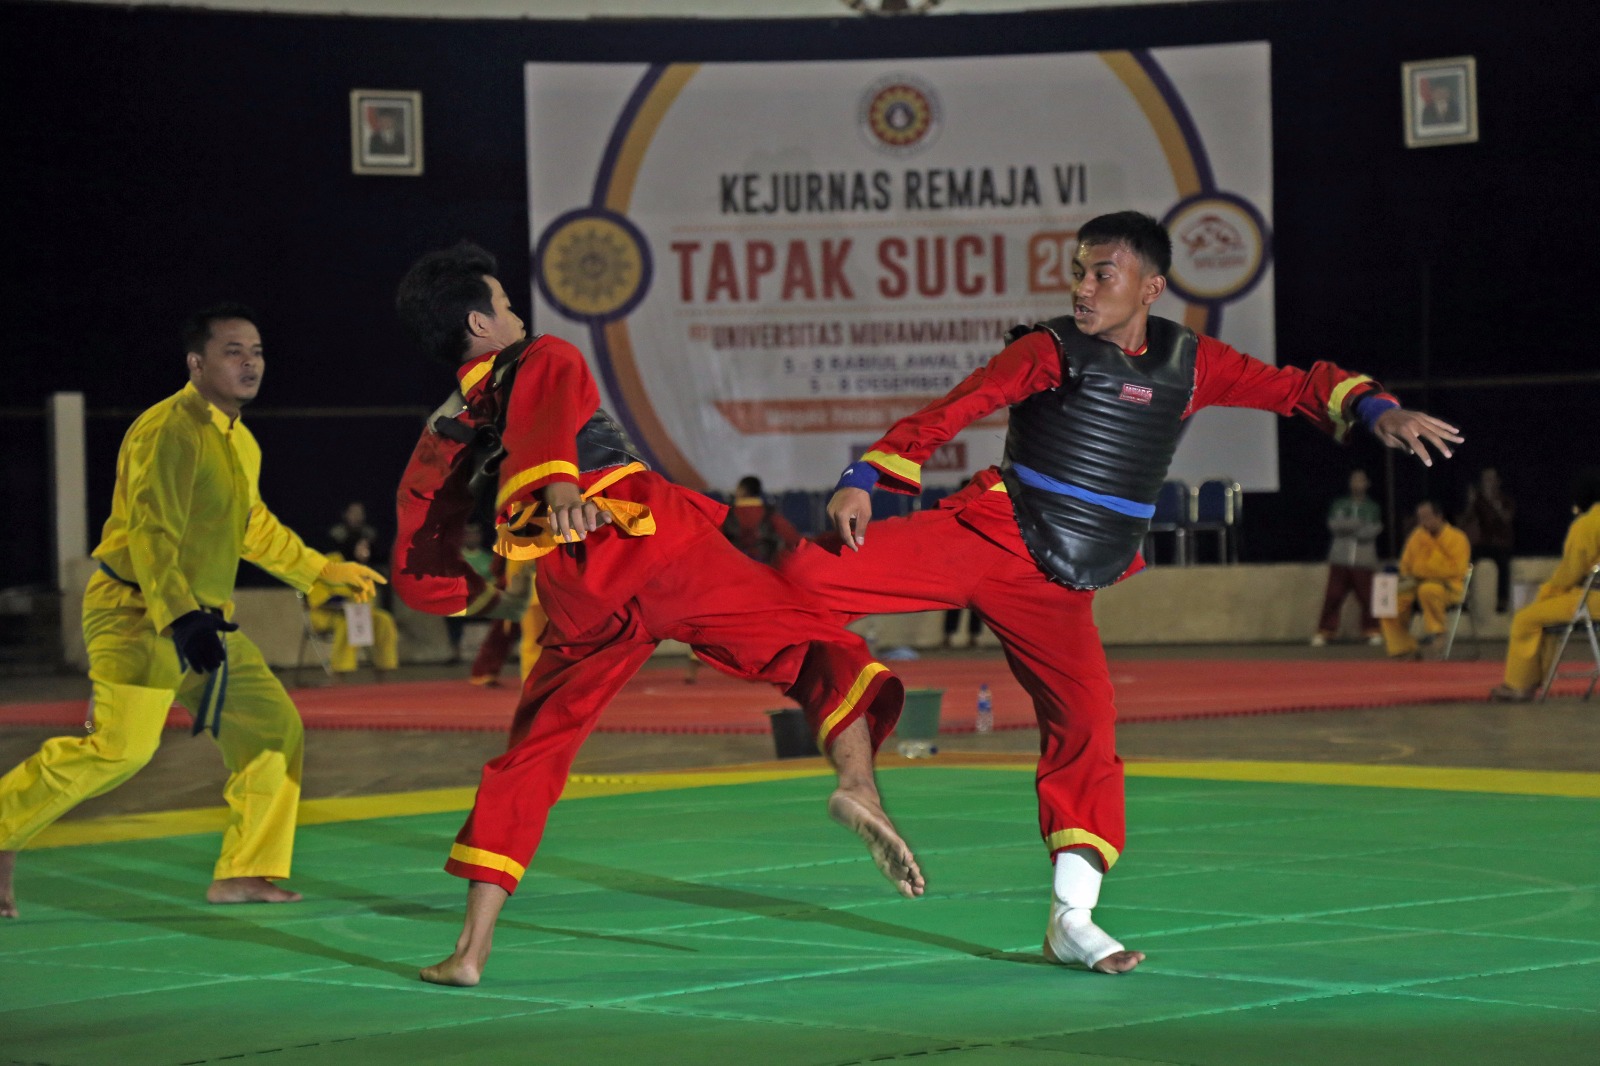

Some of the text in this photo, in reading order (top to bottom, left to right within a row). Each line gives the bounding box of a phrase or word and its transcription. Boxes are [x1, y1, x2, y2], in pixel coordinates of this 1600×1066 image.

[720, 163, 1086, 214] KEJURNAS REMAJA VI
[670, 237, 855, 303] TAPAK
[877, 232, 1006, 299] SUCI
[712, 322, 843, 350] UNIVERSITAS
[854, 374, 953, 393] DESEMBER
